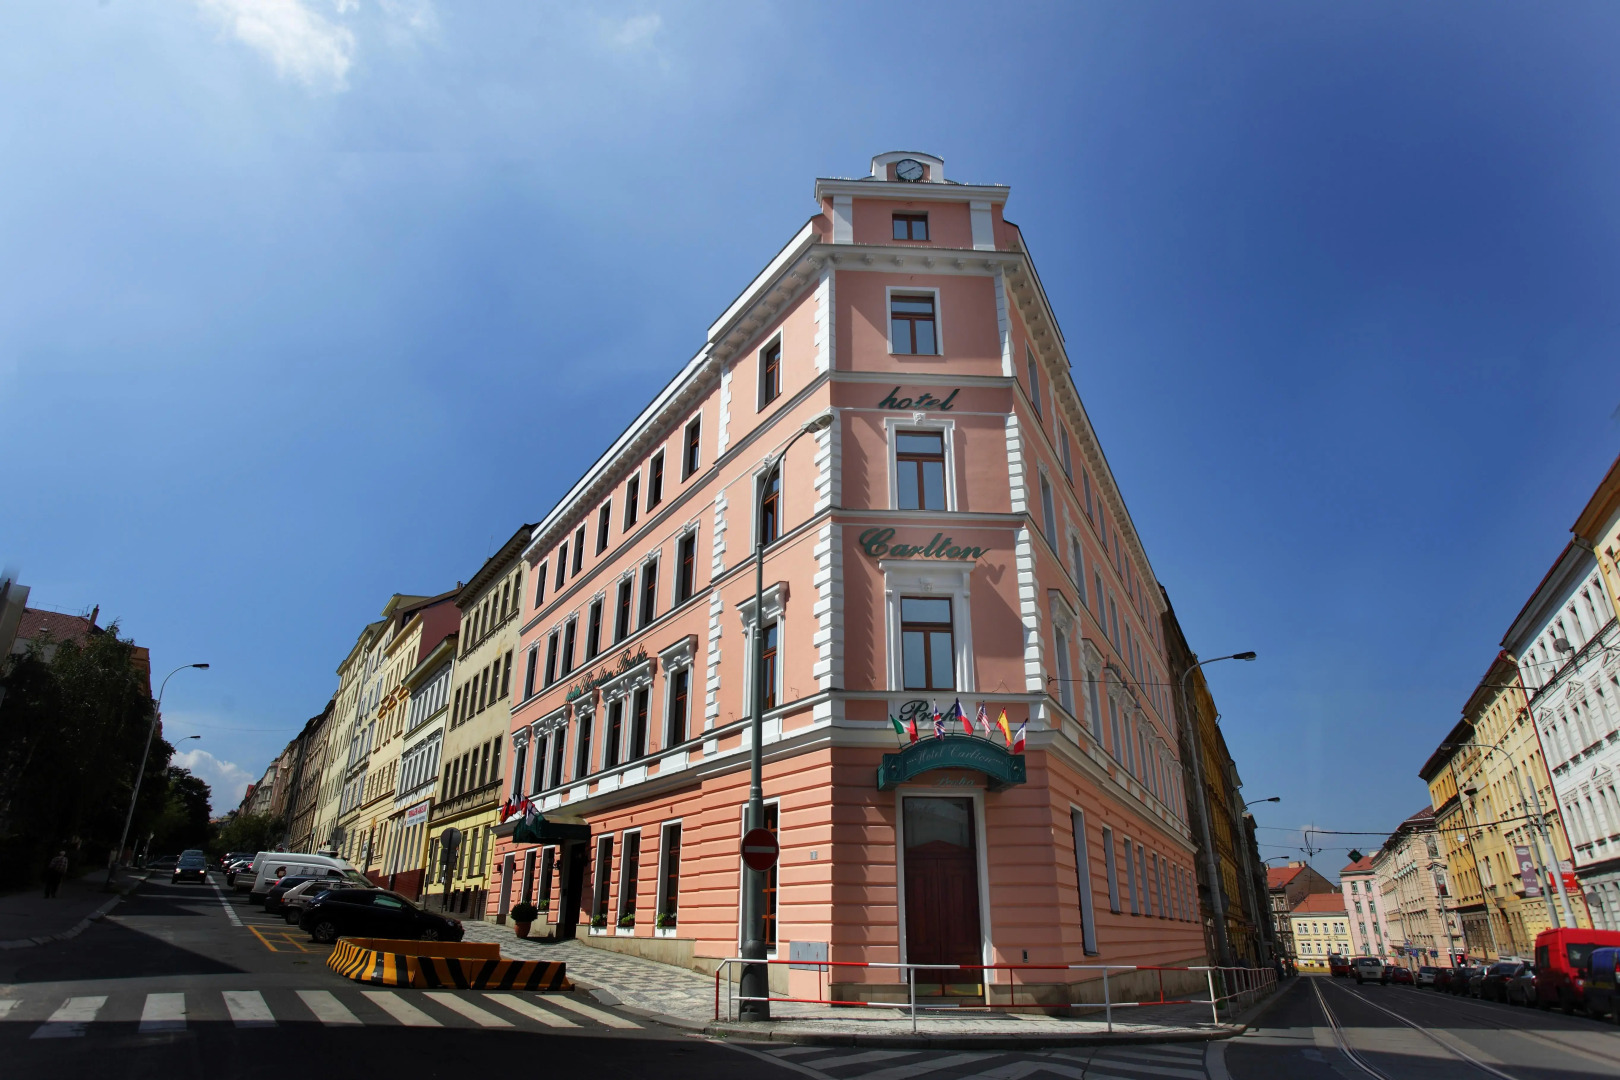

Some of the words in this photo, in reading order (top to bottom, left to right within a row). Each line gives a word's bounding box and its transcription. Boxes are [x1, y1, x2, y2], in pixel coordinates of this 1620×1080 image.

[878, 386, 960, 411] hotel
[859, 527, 991, 559] Carlton
[899, 700, 968, 722] Prh
[917, 745, 944, 764] Hotel
[948, 743, 995, 763] Carlton
